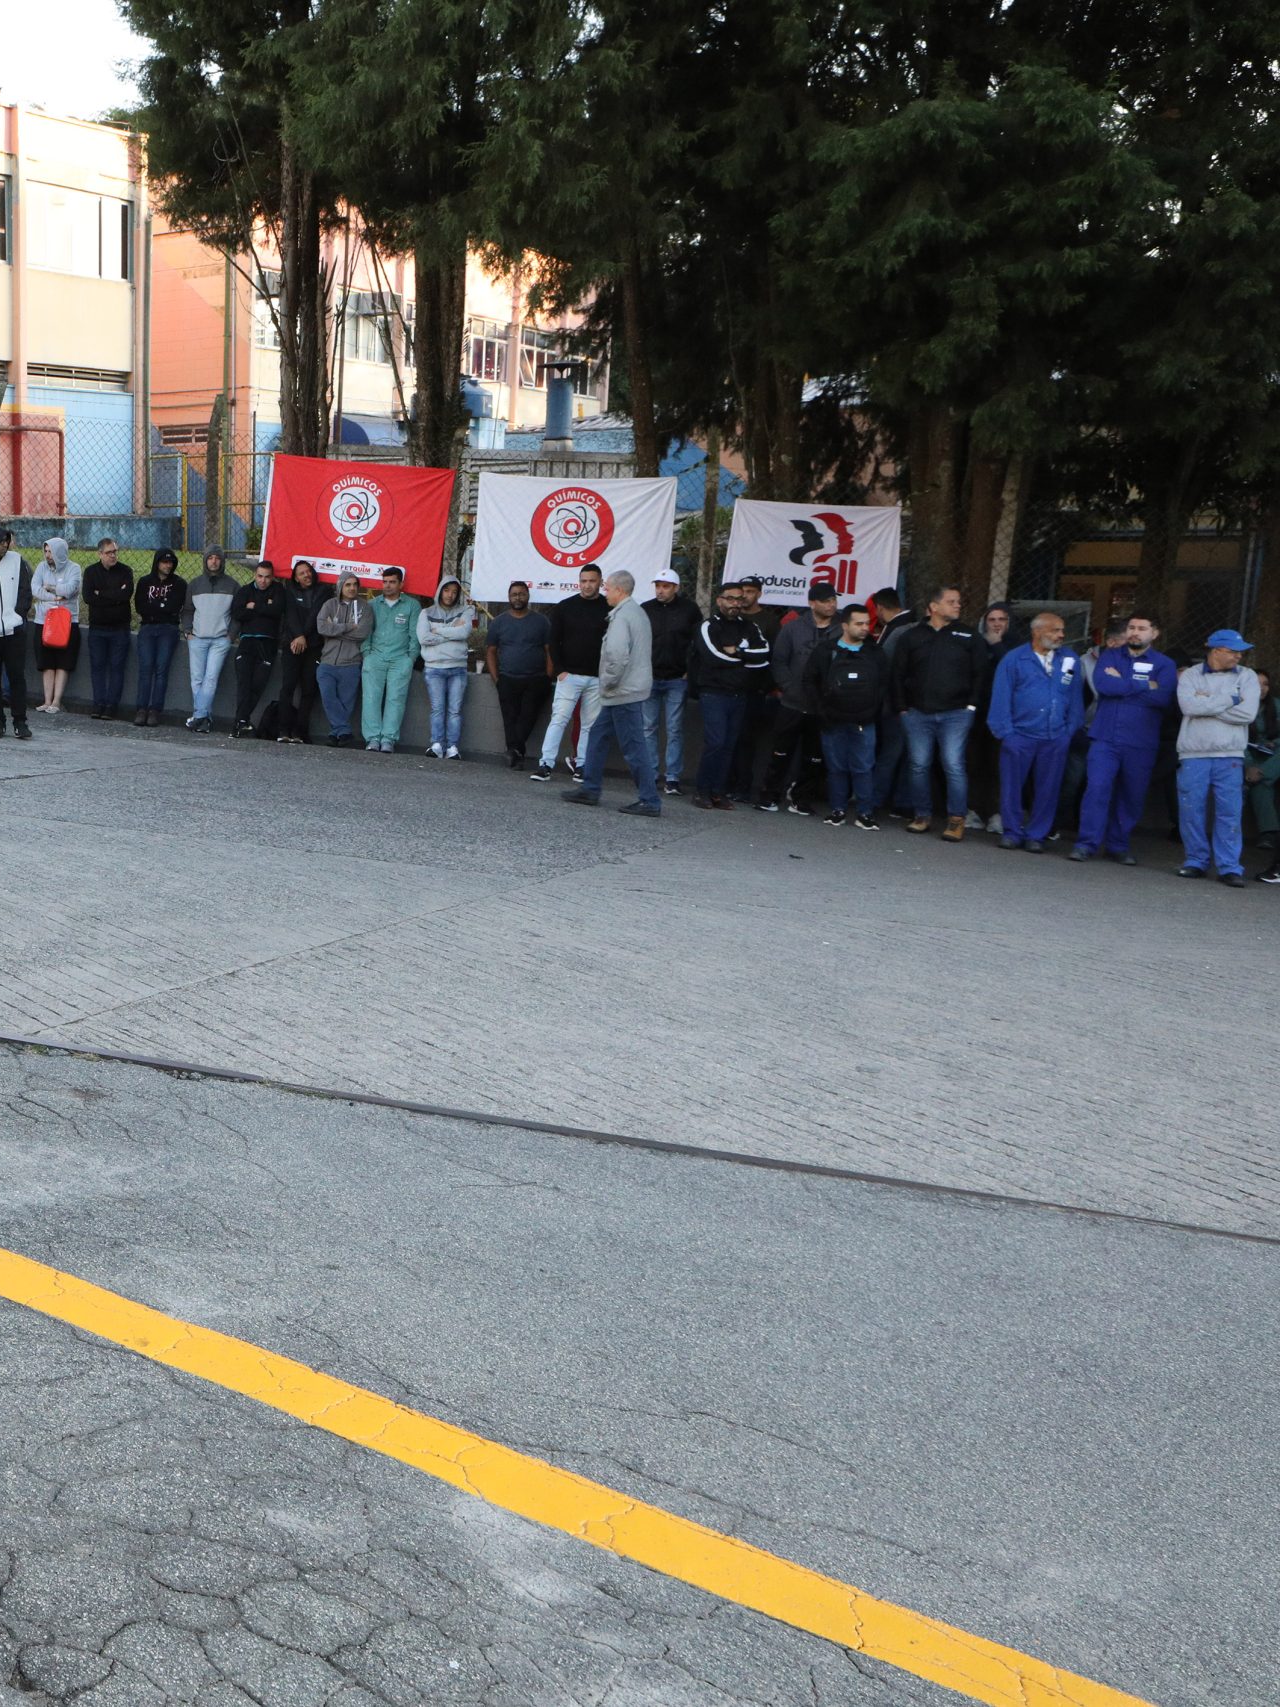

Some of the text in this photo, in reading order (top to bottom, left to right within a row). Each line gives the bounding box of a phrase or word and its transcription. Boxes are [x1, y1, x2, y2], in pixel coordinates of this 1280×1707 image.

[332, 474, 382, 497] QUÍMICOS
[547, 489, 601, 510] QUÍMICOS
[809, 559, 858, 595] all
